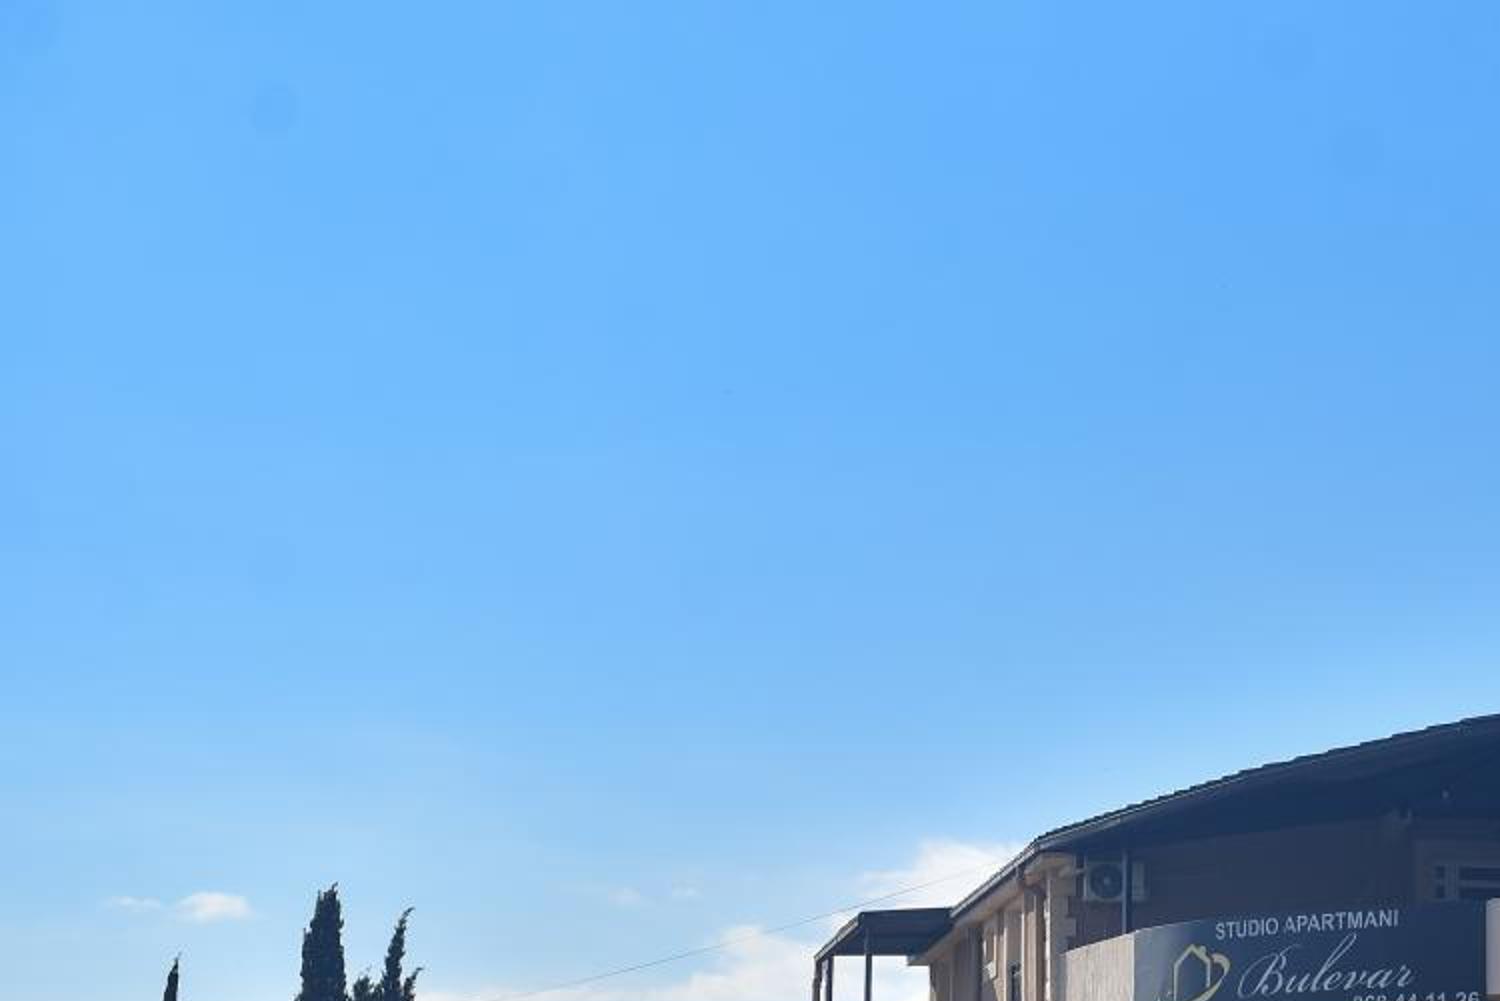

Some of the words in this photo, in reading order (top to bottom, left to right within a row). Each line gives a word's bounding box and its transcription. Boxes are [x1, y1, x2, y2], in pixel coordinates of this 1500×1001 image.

[1215, 917, 1279, 941] STUDIO
[1283, 909, 1399, 934] APARTMANI
[1236, 932, 1414, 999] Bulevar
